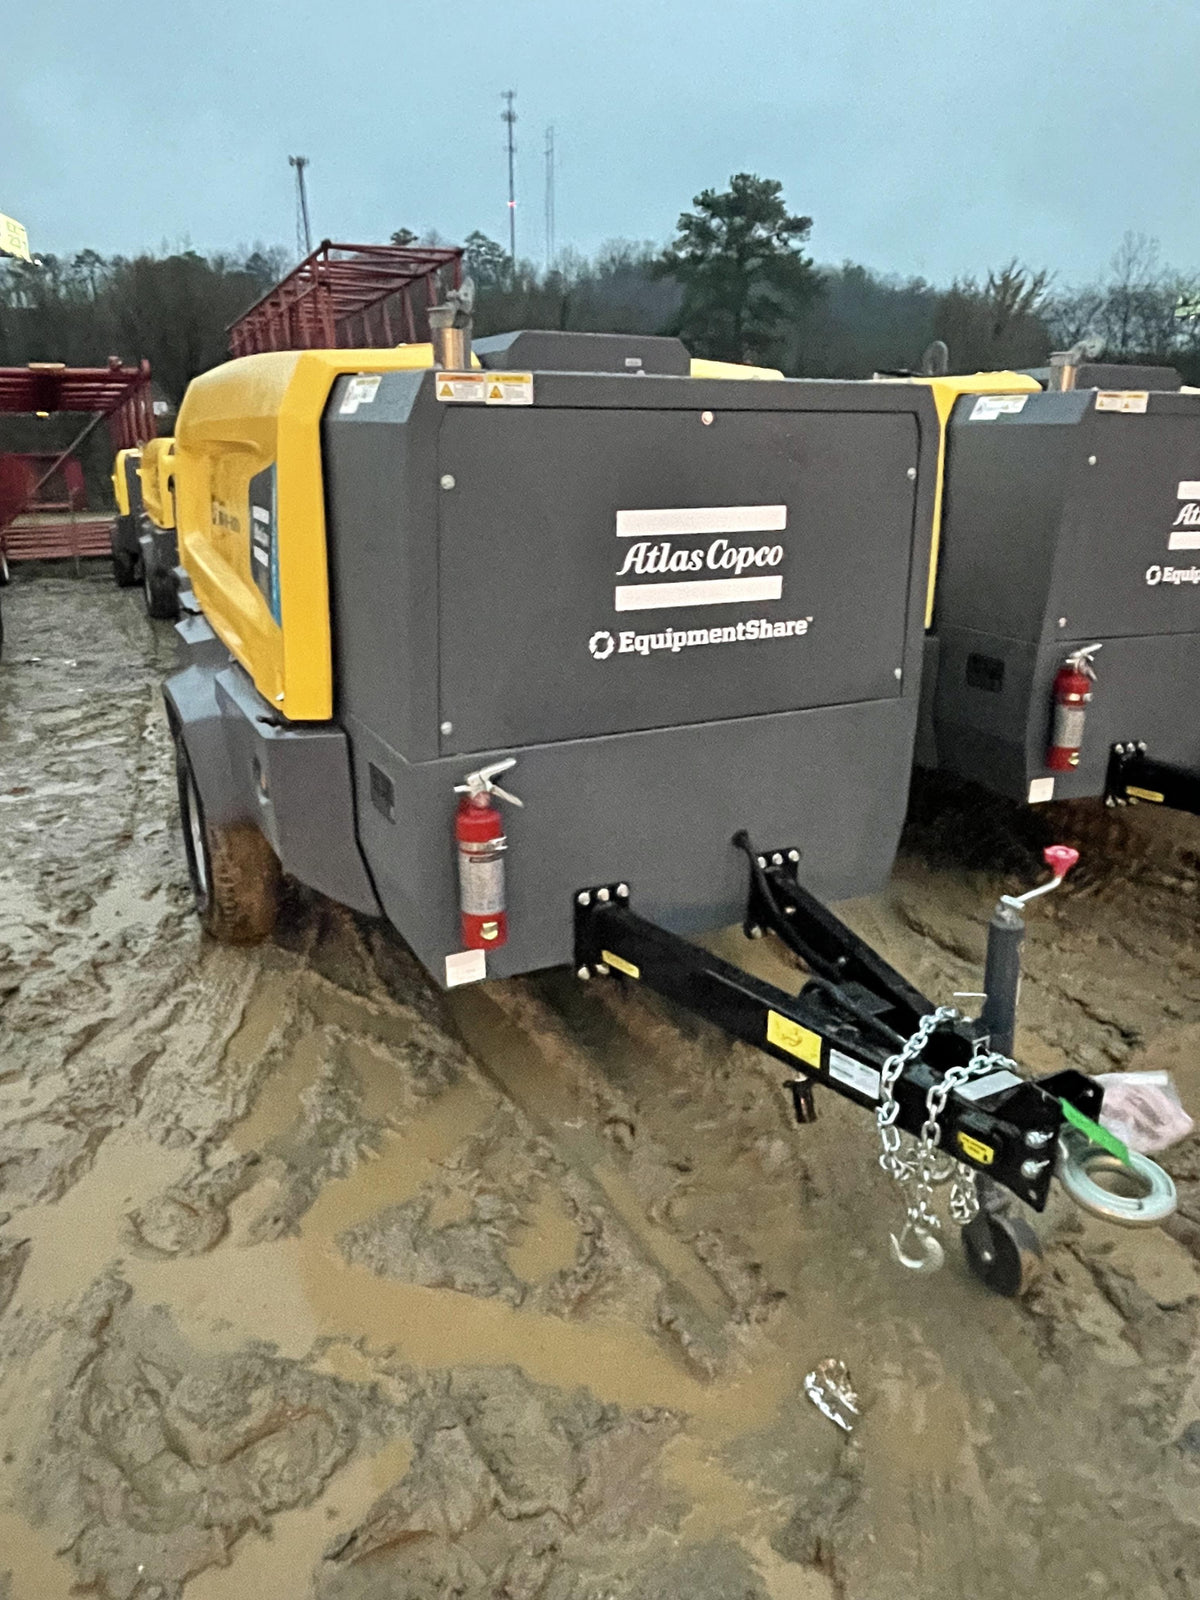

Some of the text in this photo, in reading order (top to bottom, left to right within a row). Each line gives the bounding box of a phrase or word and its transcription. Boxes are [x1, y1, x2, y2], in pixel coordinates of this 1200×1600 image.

[615, 539, 784, 576] Atlas Copco
[618, 619, 808, 655] EquipmentShare
